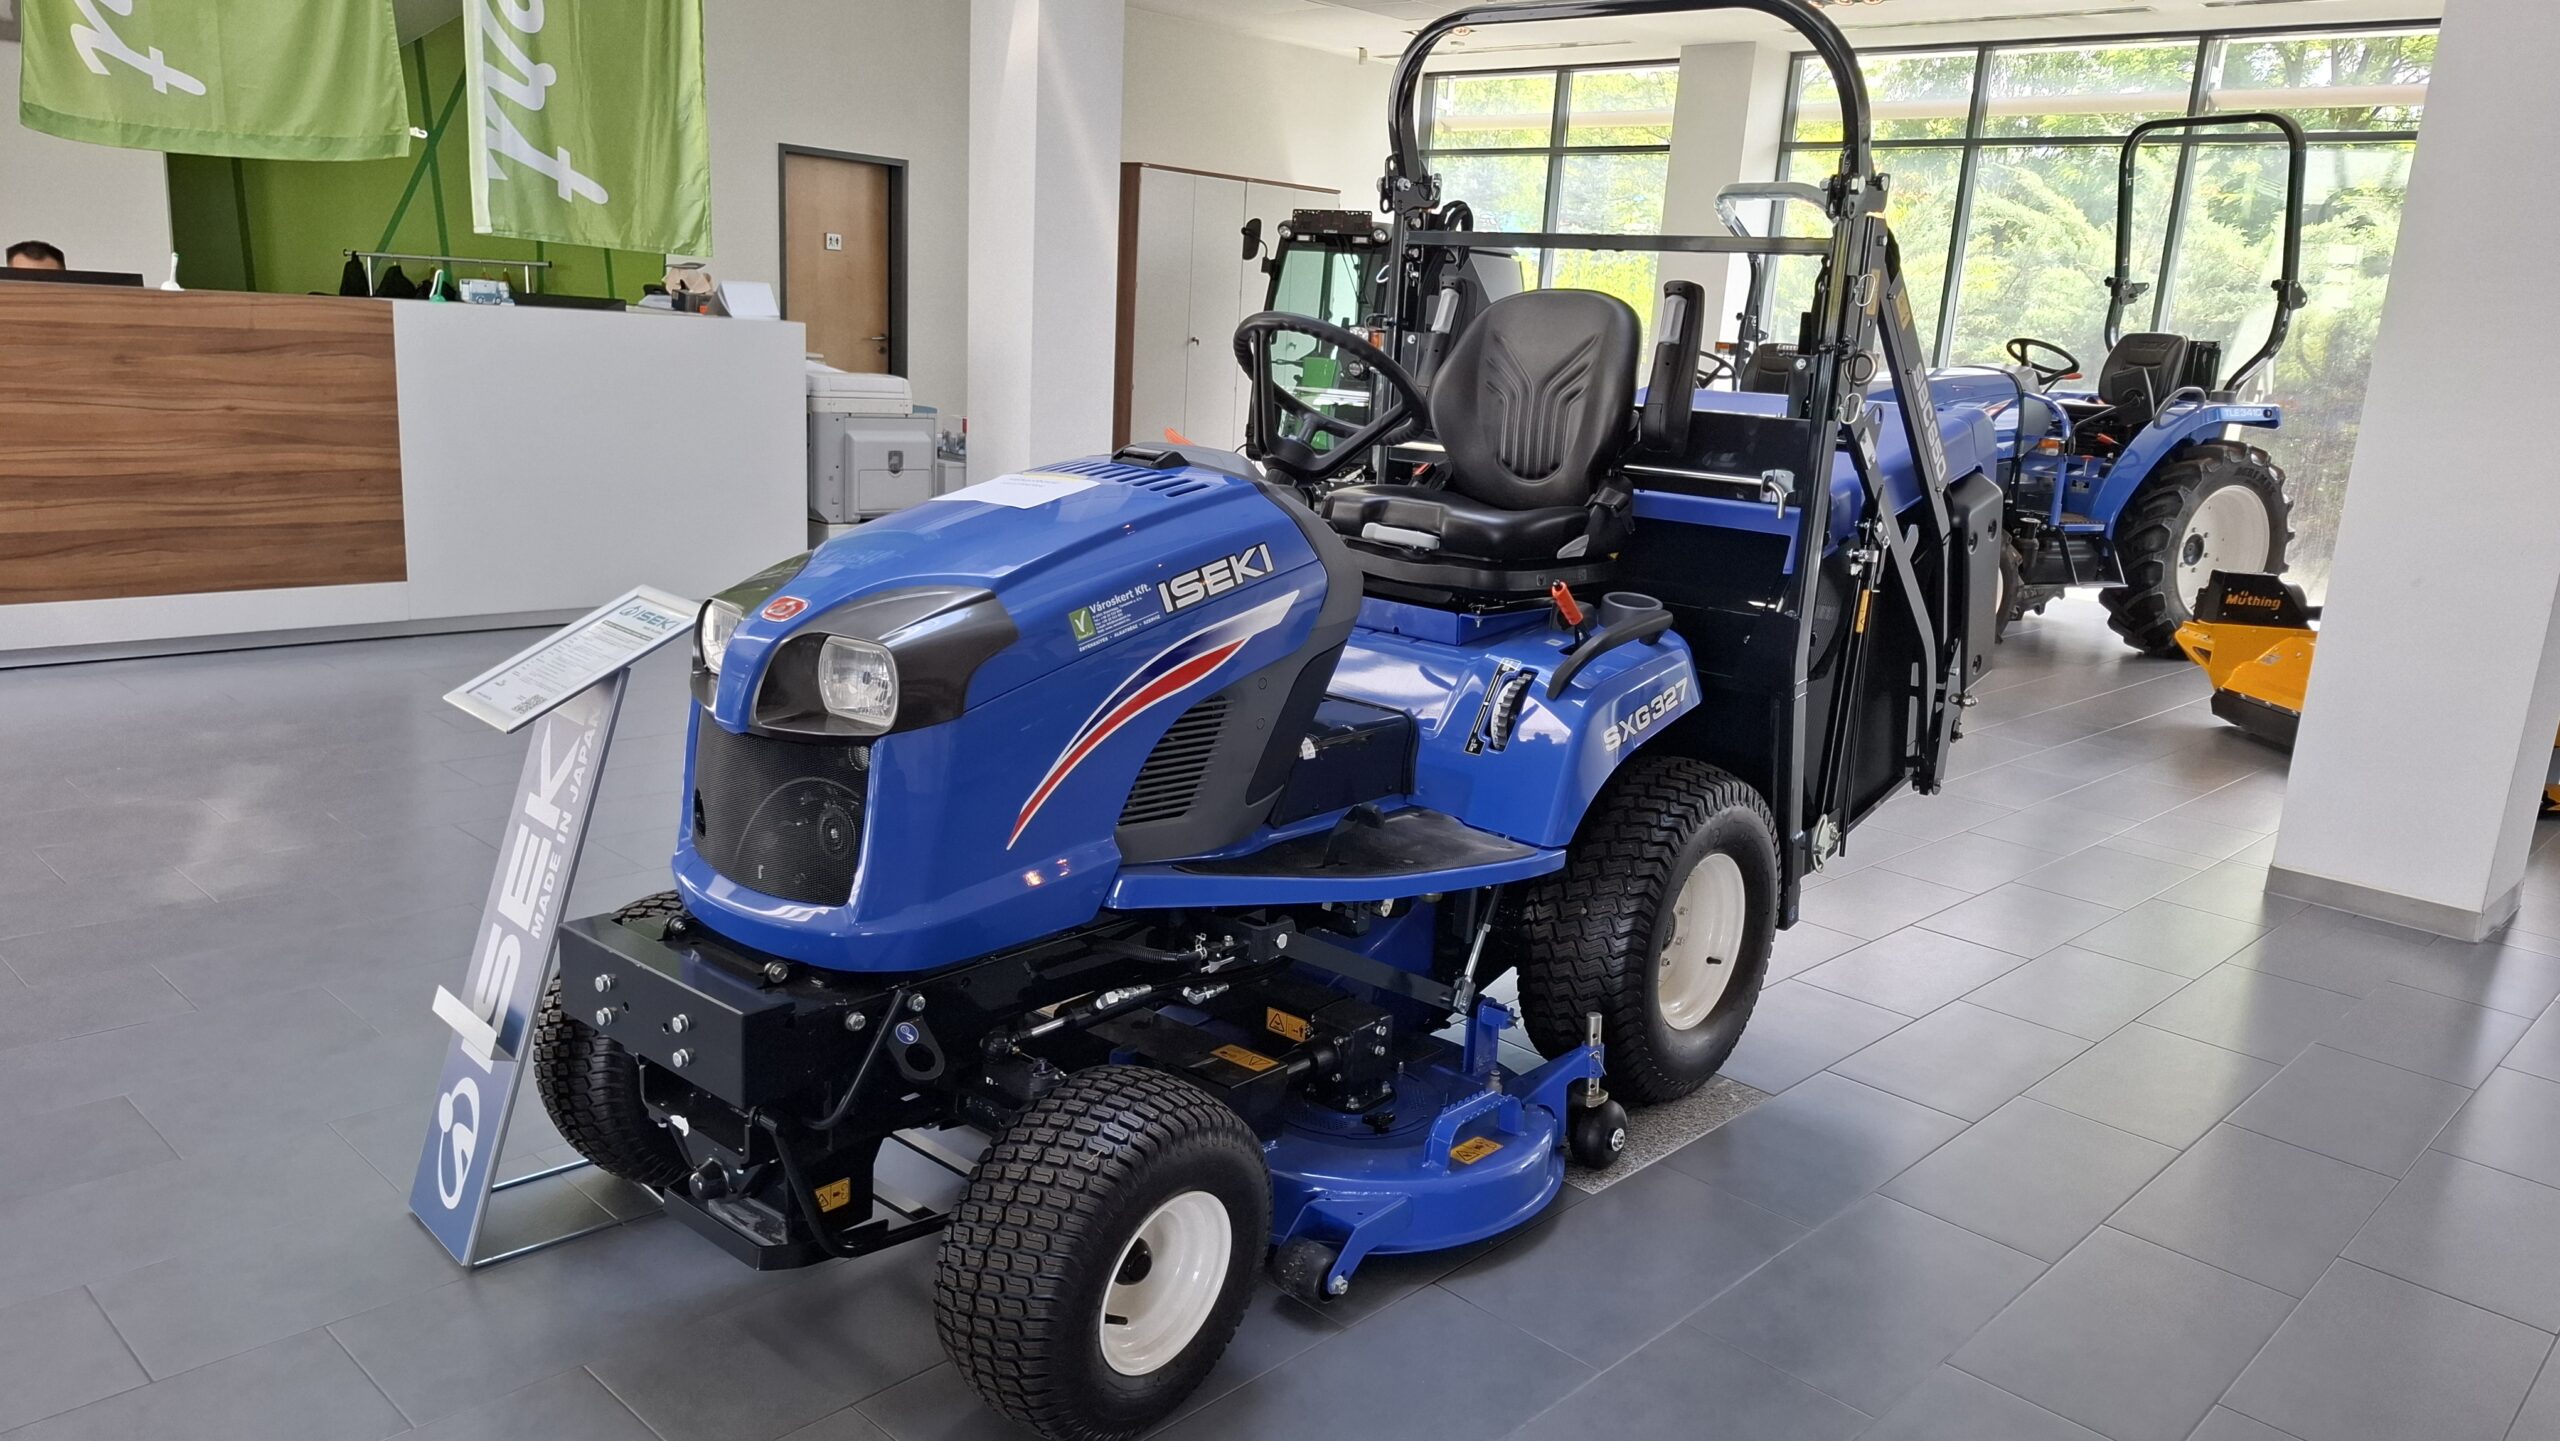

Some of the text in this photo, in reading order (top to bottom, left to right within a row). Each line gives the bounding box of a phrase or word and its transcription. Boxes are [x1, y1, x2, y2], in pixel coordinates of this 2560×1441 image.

[1089, 583, 1152, 614] Városkert Kft.
[1157, 542, 1275, 614] ISEKI
[2225, 590, 2281, 611] Müthing
[632, 609, 681, 631] ISEKI
[1602, 678, 1688, 752] SXG327
[530, 851, 562, 940] MADE
[556, 811, 573, 844] IN
